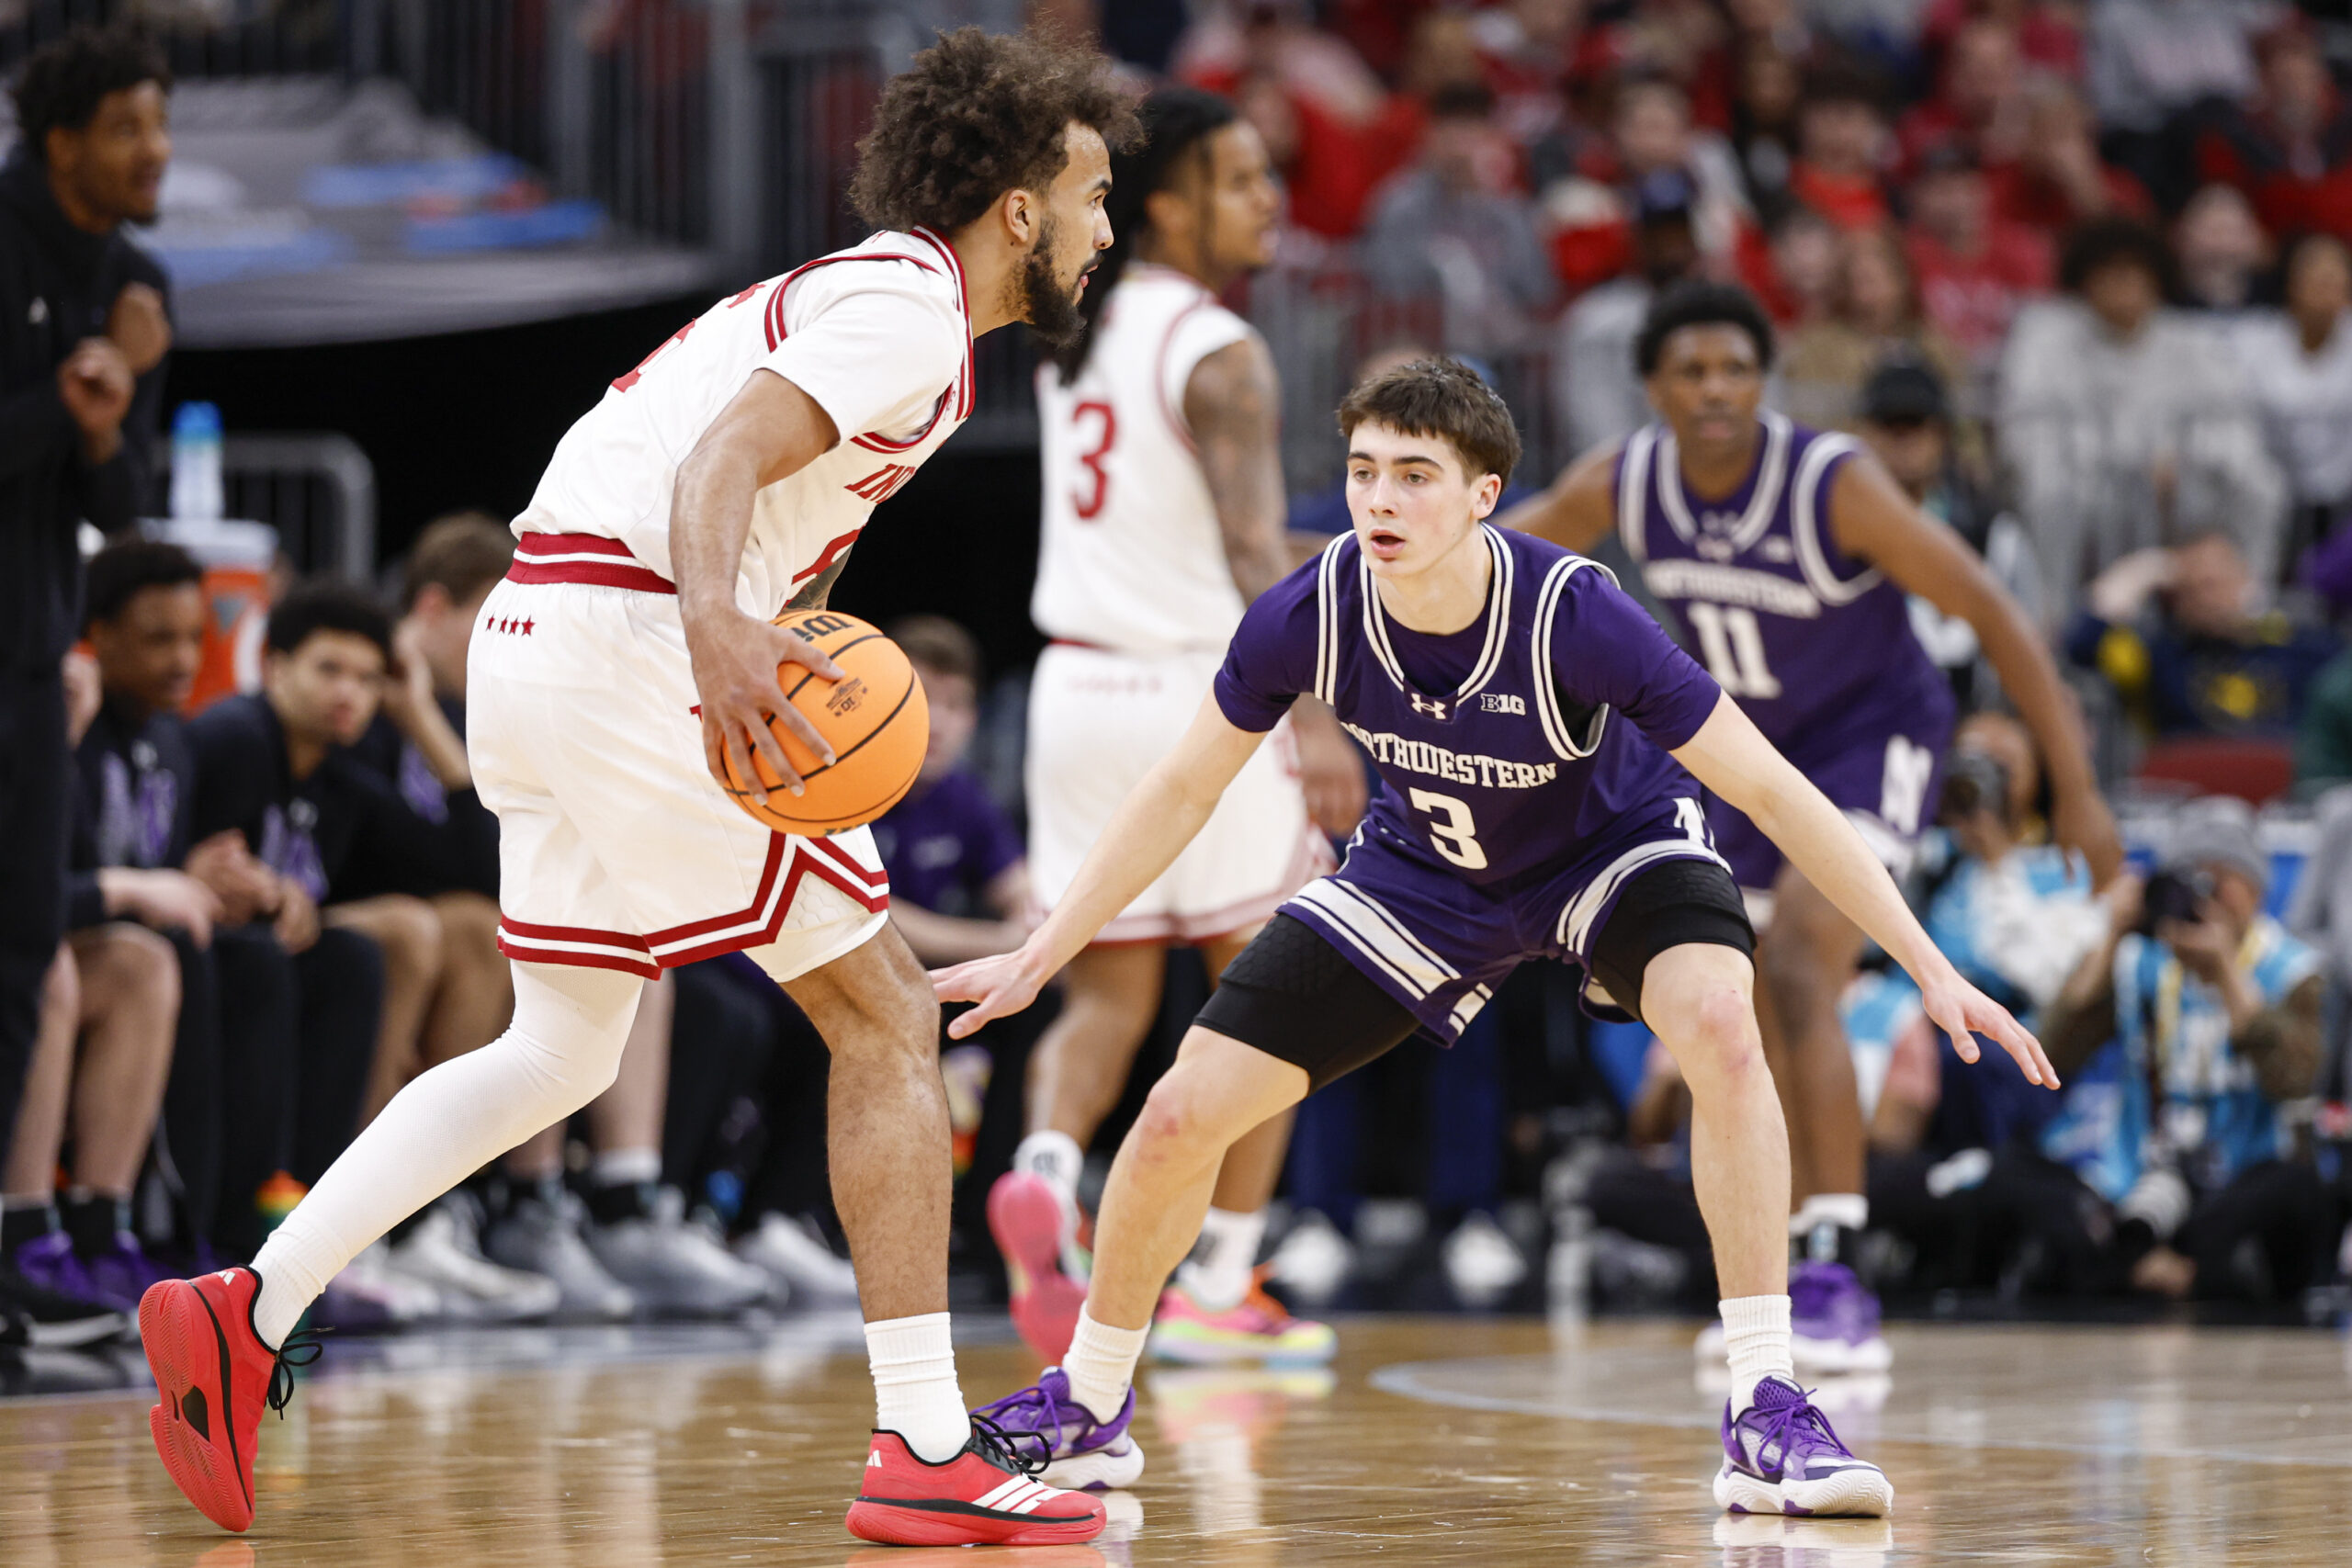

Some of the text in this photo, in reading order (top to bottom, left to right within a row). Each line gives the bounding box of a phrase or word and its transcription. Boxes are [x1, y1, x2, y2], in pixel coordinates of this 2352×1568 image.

[1071, 400, 1118, 521] 3
[1687, 602, 1782, 700] 11
[1408, 787, 1488, 870] 3
